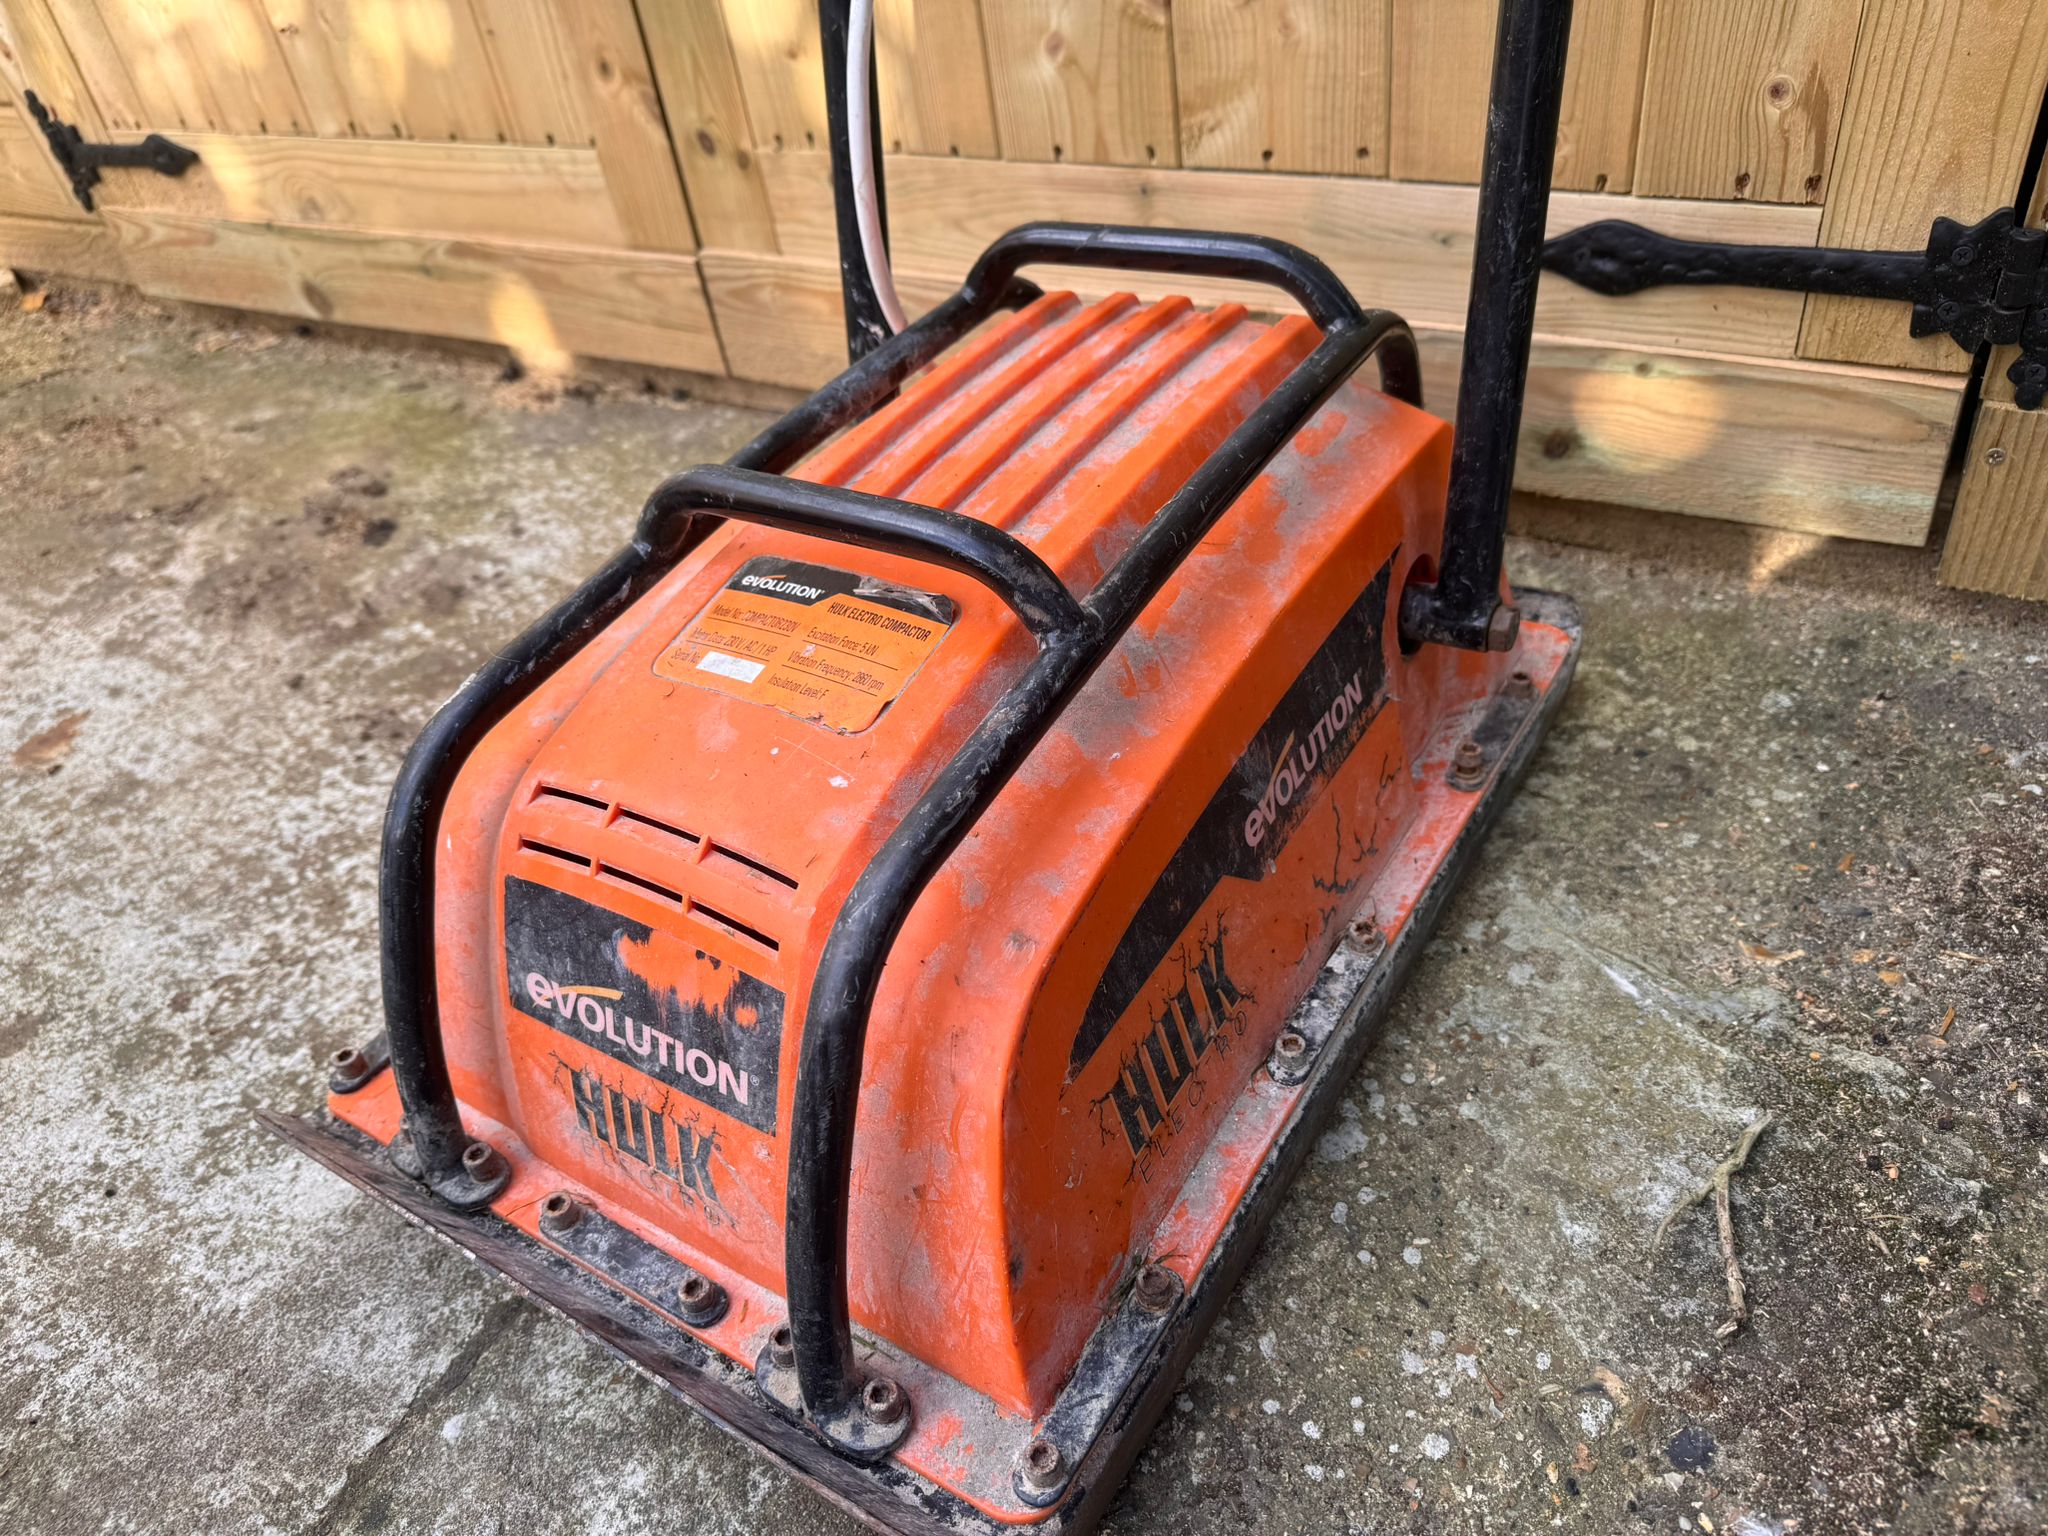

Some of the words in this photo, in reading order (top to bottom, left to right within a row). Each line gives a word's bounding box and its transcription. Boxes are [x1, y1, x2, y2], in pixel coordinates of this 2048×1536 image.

[713, 604, 732, 617] Model
[827, 602, 851, 616] HULK
[848, 610, 882, 625] ELECTRO
[881, 617, 931, 641] COMPACTOR
[724, 636, 740, 647] 230
[765, 645, 778, 656] HP
[807, 627, 839, 645] Excitation
[838, 636, 862, 651] Force:
[866, 645, 879, 656] kN
[768, 673, 801, 691] Insulation
[799, 683, 823, 697] Level:
[787, 651, 819, 669] Vibration
[816, 659, 852, 682] Frequency:
[868, 678, 885, 691] rpm
[1108, 938, 1243, 1159] HULK
[567, 1066, 723, 1203] HULK
